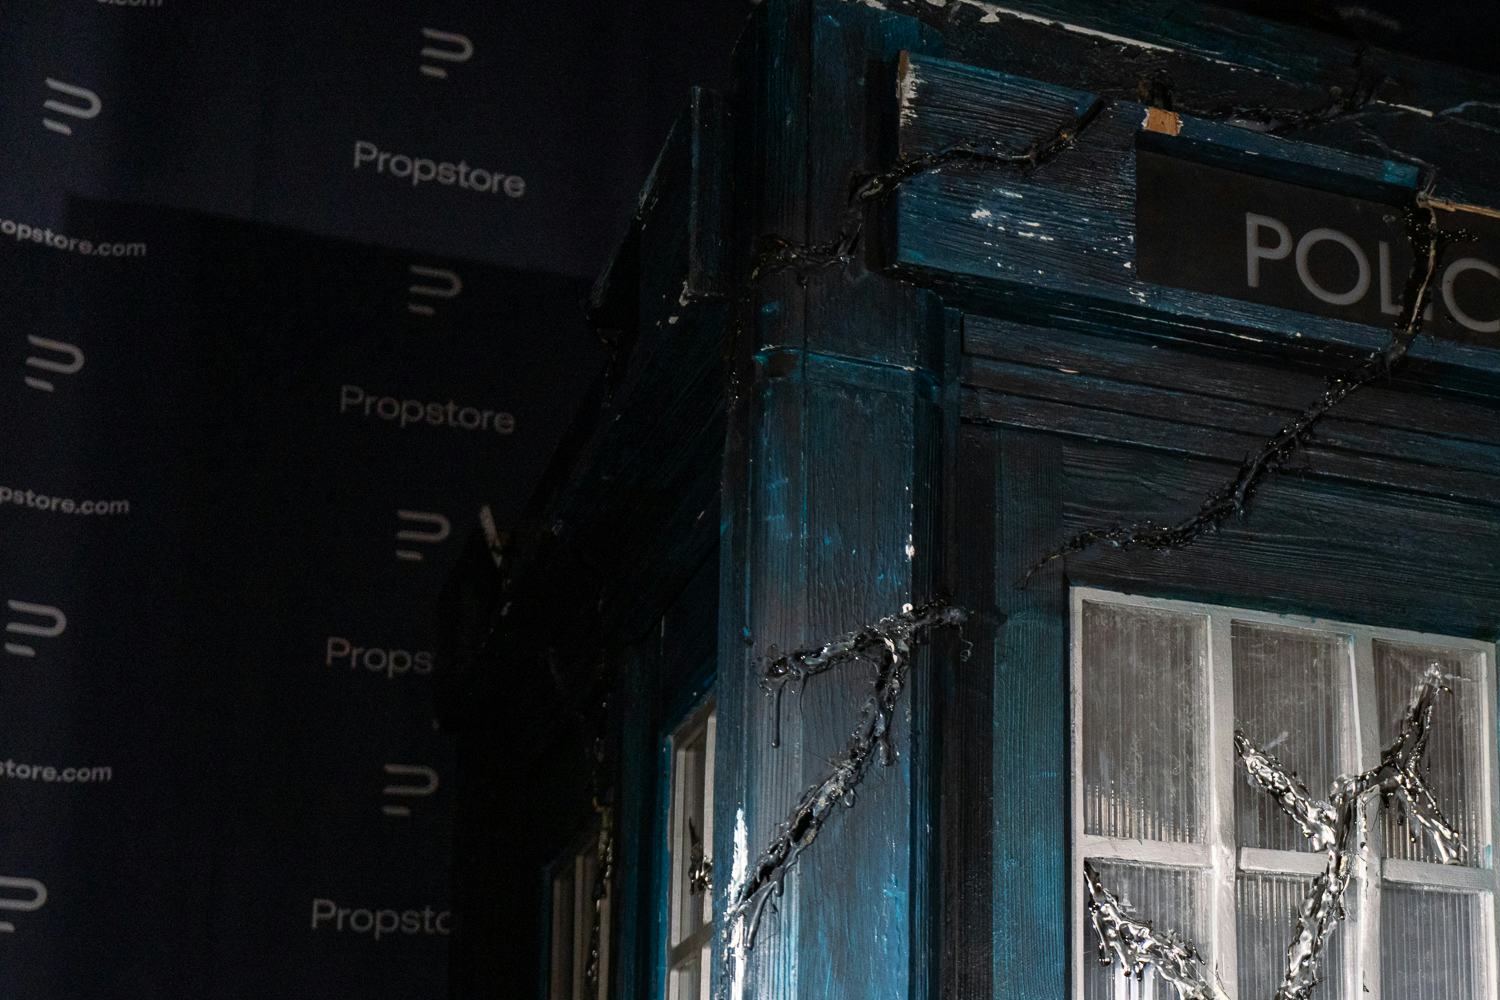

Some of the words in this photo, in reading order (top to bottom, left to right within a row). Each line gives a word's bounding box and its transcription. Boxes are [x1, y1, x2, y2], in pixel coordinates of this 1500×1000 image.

[353, 140, 526, 198] Propstore
[0, 217, 146, 256] opstore.com
[340, 384, 516, 435] Propstore
